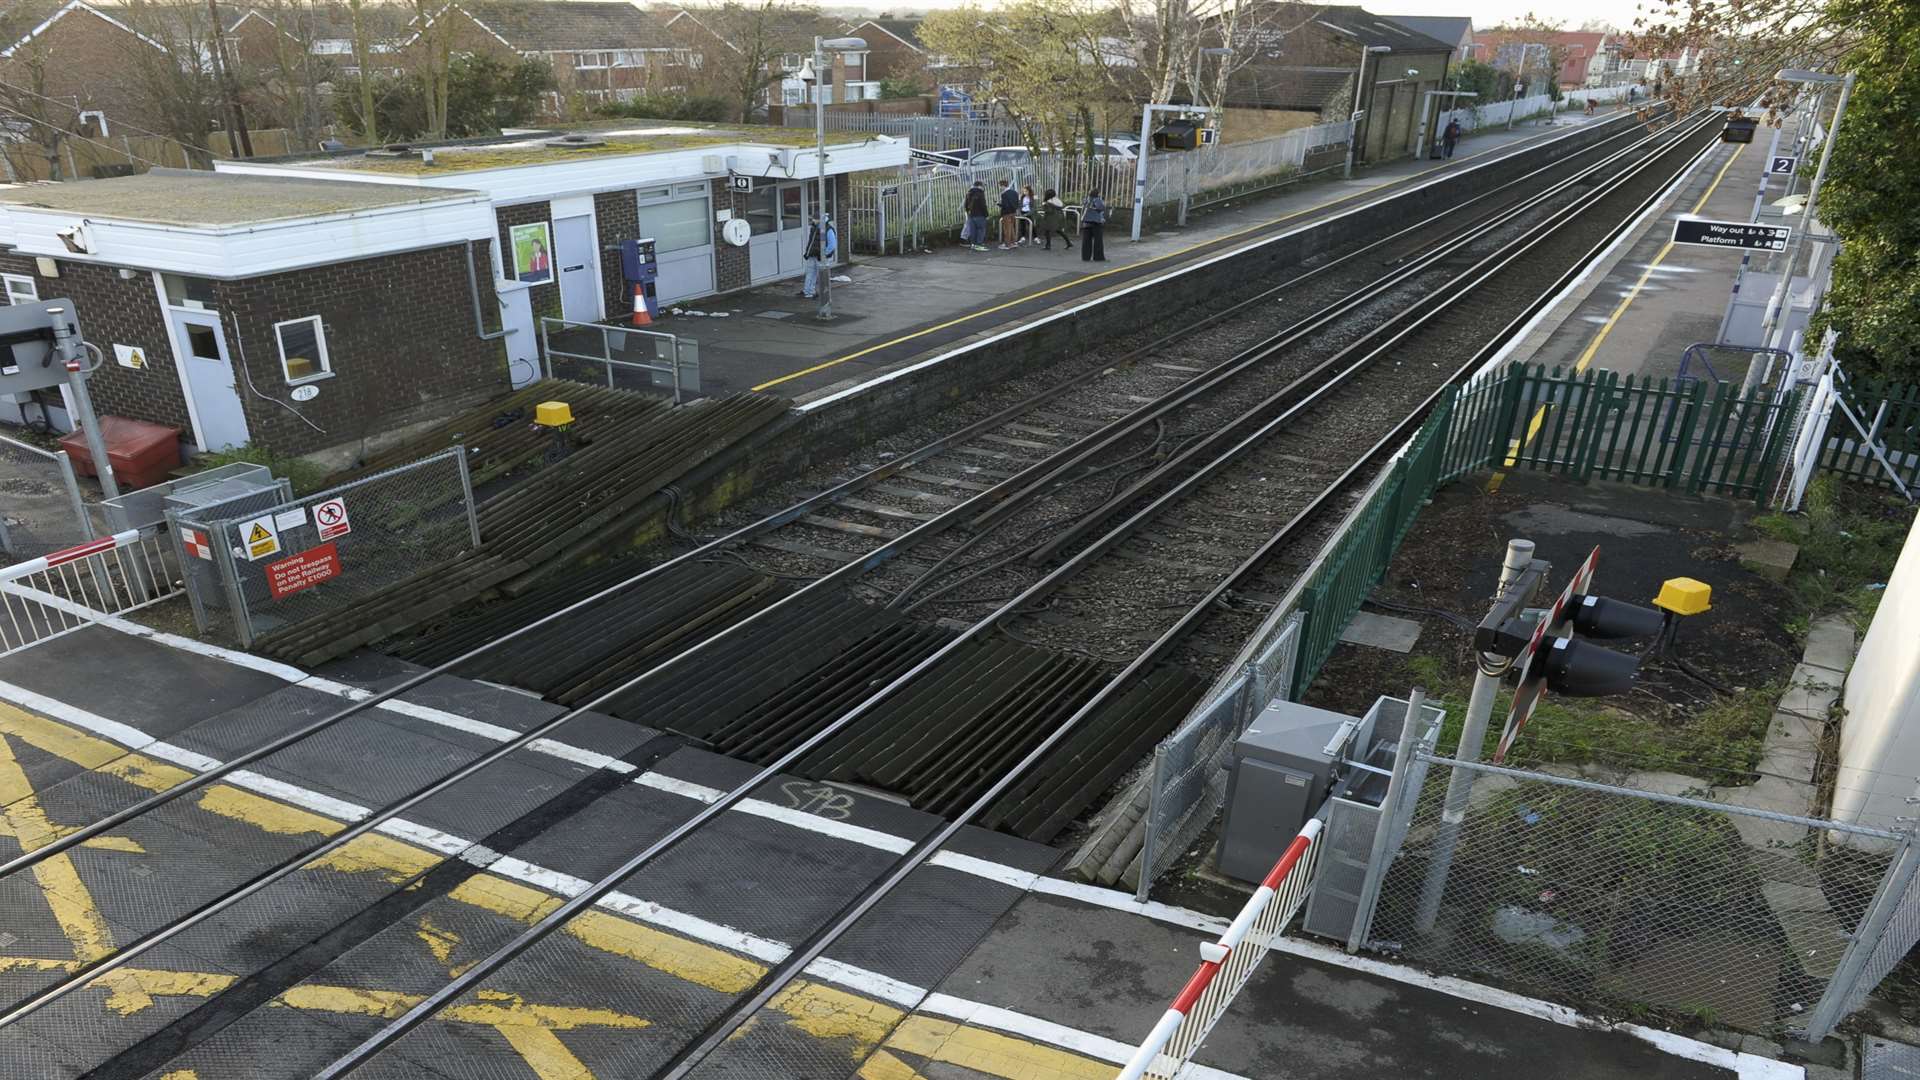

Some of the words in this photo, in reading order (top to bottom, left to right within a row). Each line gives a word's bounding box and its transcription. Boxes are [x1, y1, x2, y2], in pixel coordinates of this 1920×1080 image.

[1777, 159, 1789, 172] 2
[1710, 225, 1728, 234] Way
[1700, 235, 1737, 245] Platform
[272, 556, 304, 572] Warning
[274, 572, 287, 580] Do
[287, 567, 301, 576] not
[301, 555, 332, 571] trespass
[276, 580, 288, 588] on
[288, 574, 301, 583] the
[301, 563, 330, 578] Railway
[278, 579, 307, 593] Penalty
[307, 569, 332, 583] £1000
